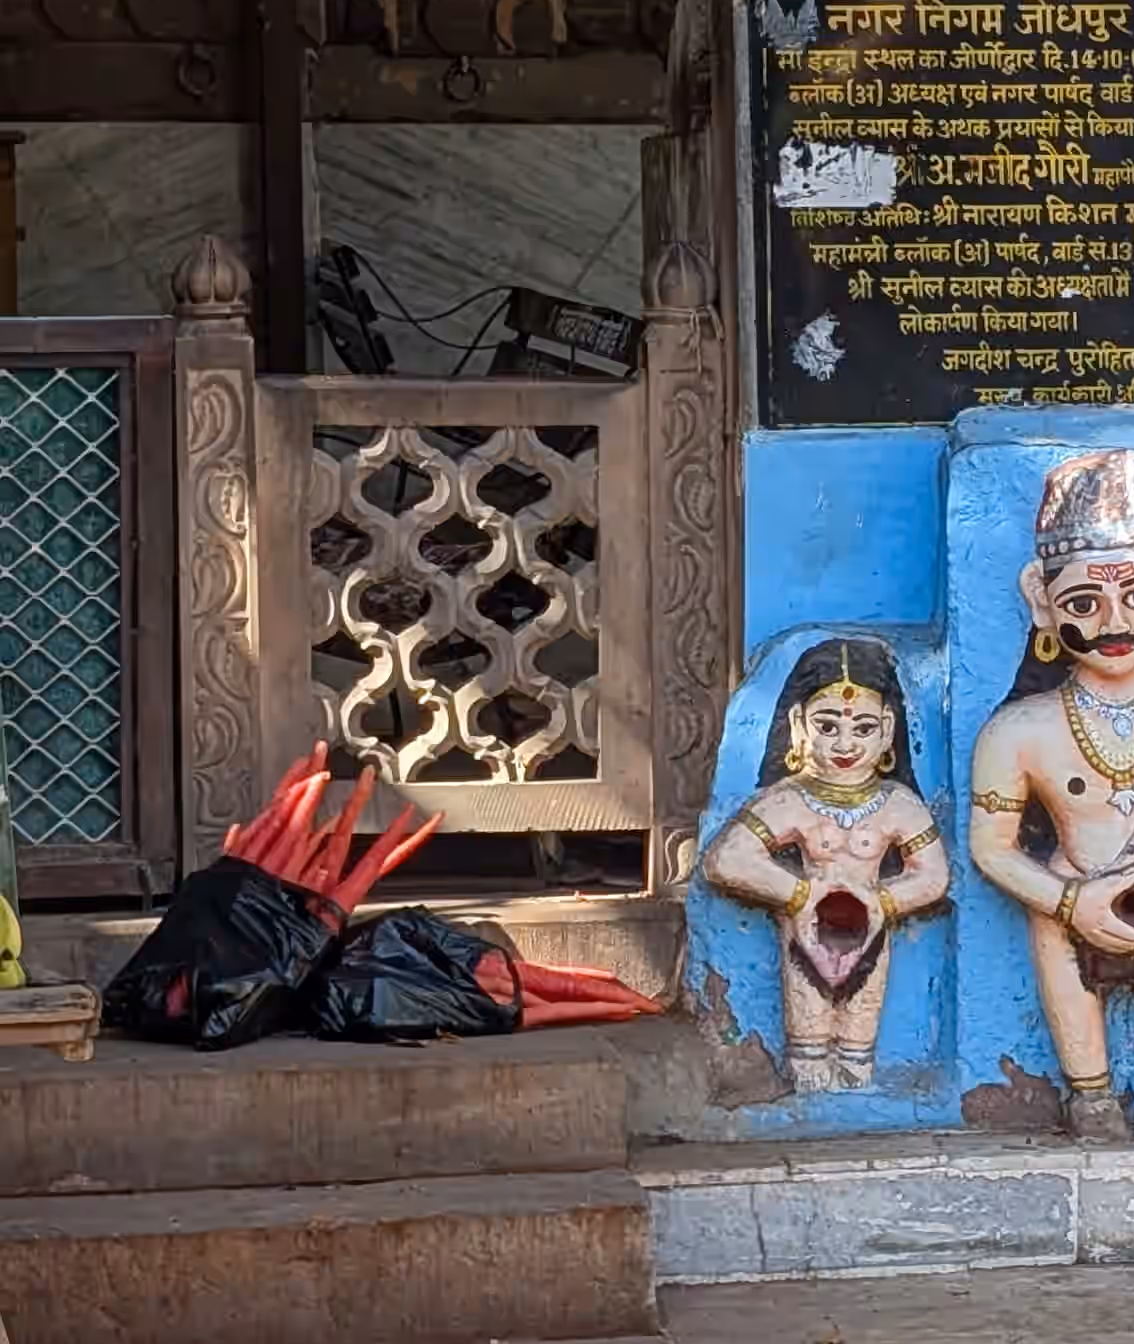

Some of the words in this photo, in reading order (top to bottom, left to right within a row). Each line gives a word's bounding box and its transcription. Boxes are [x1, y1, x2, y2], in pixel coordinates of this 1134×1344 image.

[825, 4, 905, 36] नगर
[864, 49, 914, 71] स्थल
[919, 49, 946, 70] का
[888, 82, 957, 105] अध्यक्ष
[959, 80, 988, 108] एवं
[992, 83, 1038, 104] नगर
[1042, 75, 1095, 108] पार्षद
[793, 111, 853, 141] सुनील
[857, 118, 909, 139] व्यास
[912, 110, 933, 138] के
[937, 118, 991, 139] अथक
[1064, 110, 1084, 138] से
[932, 195, 960, 227] श्री
[962, 204, 1042, 228] नारायण
[1045, 194, 1119, 226] किशन
[1052, 233, 1086, 262] वार्ड
[848, 268, 874, 301] श्री
[880, 268, 945, 306] सुनील
[949, 276, 1003, 300] व्यास
[899, 304, 977, 335] लोकार्पण
[982, 304, 1027, 334] किया
[942, 340, 1011, 374] जगदीश
[1014, 348, 1061, 375] चन्द्र
